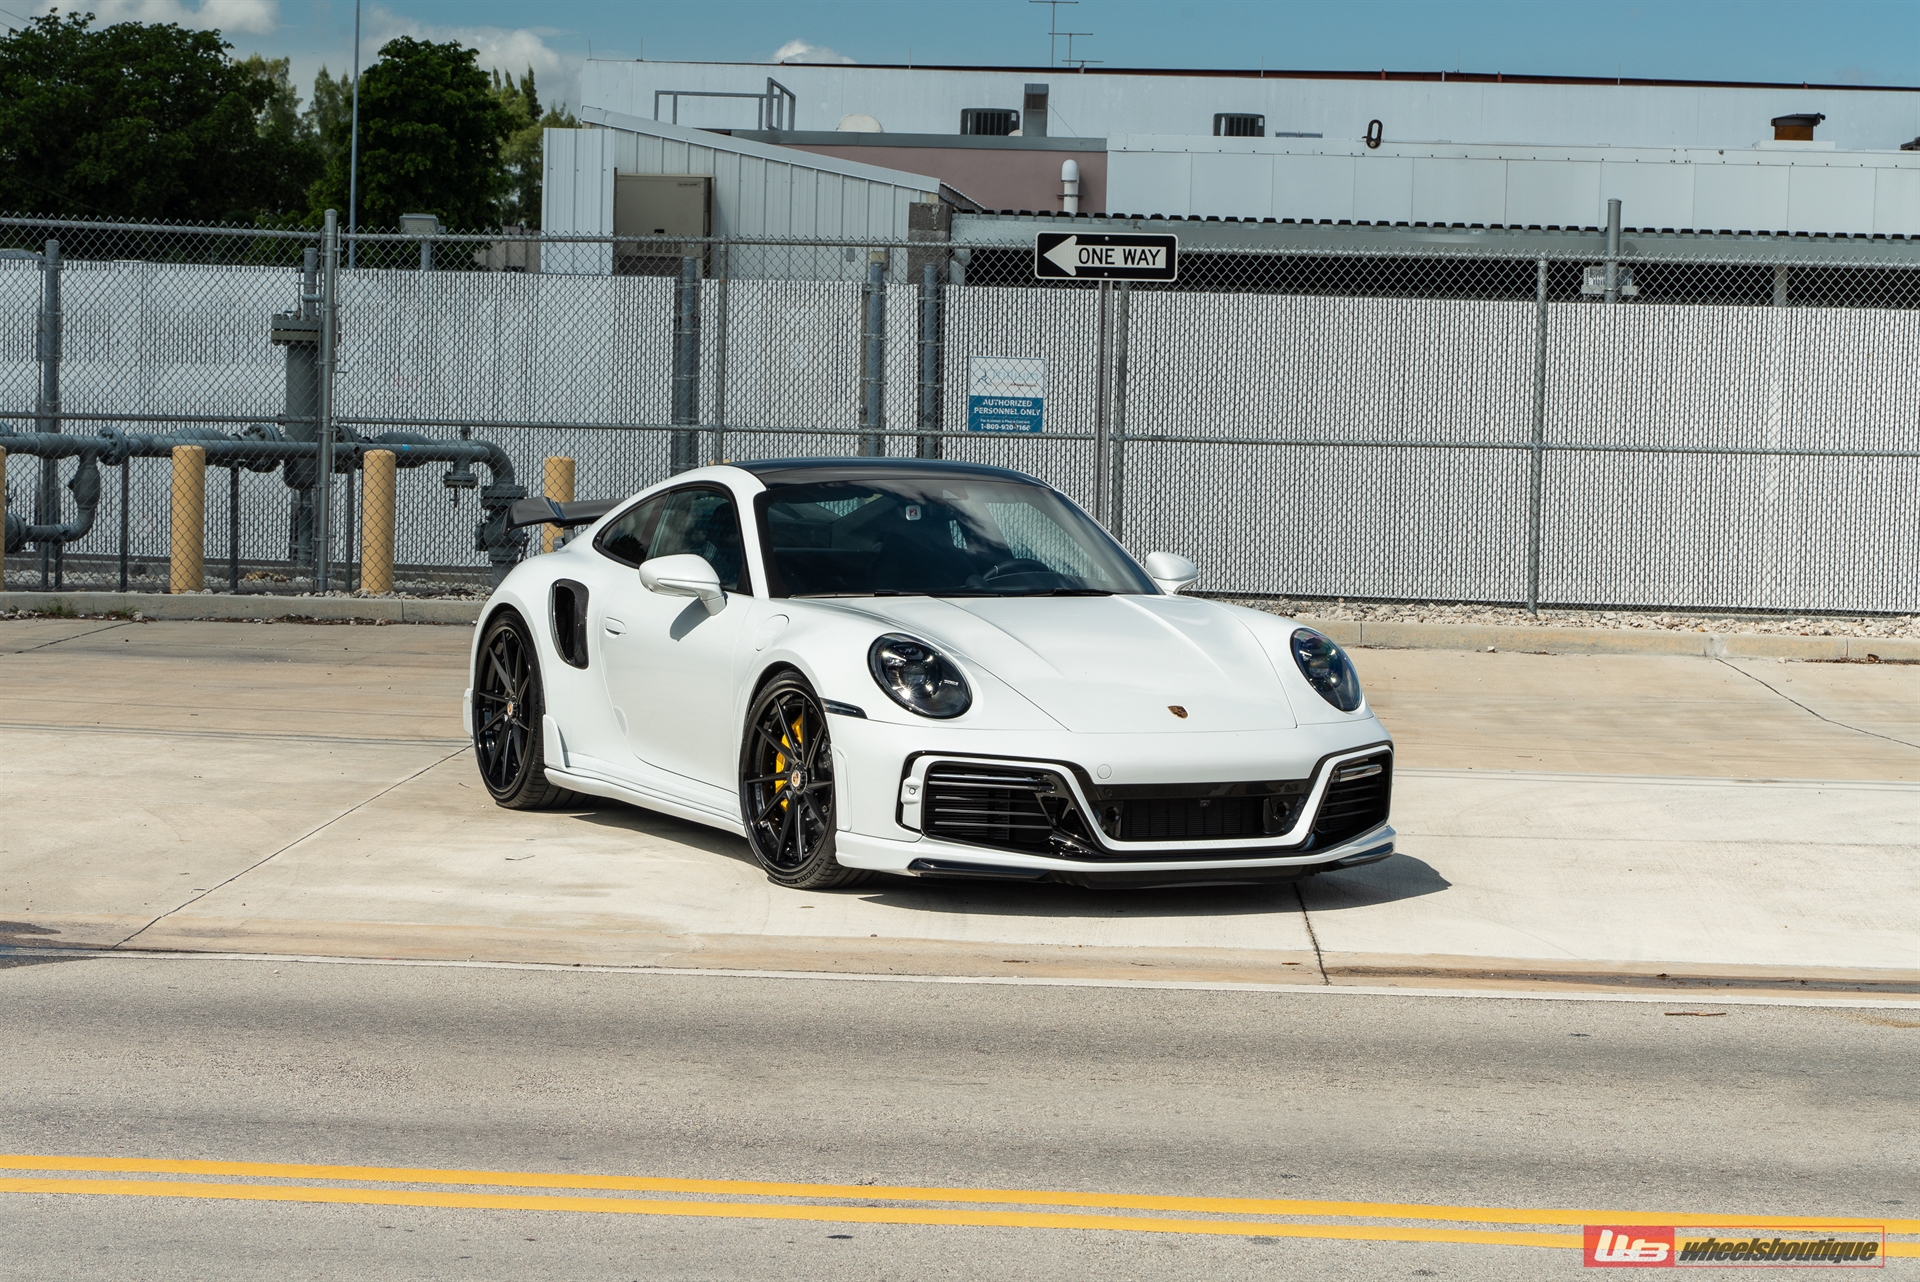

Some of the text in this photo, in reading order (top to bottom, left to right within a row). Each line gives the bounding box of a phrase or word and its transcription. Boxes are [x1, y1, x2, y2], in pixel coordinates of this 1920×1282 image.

[1078, 247, 1162, 266] ONE WAY
[982, 399, 1033, 407] AUTHORIZED
[973, 407, 1041, 416] PERSONNEL ONLY
